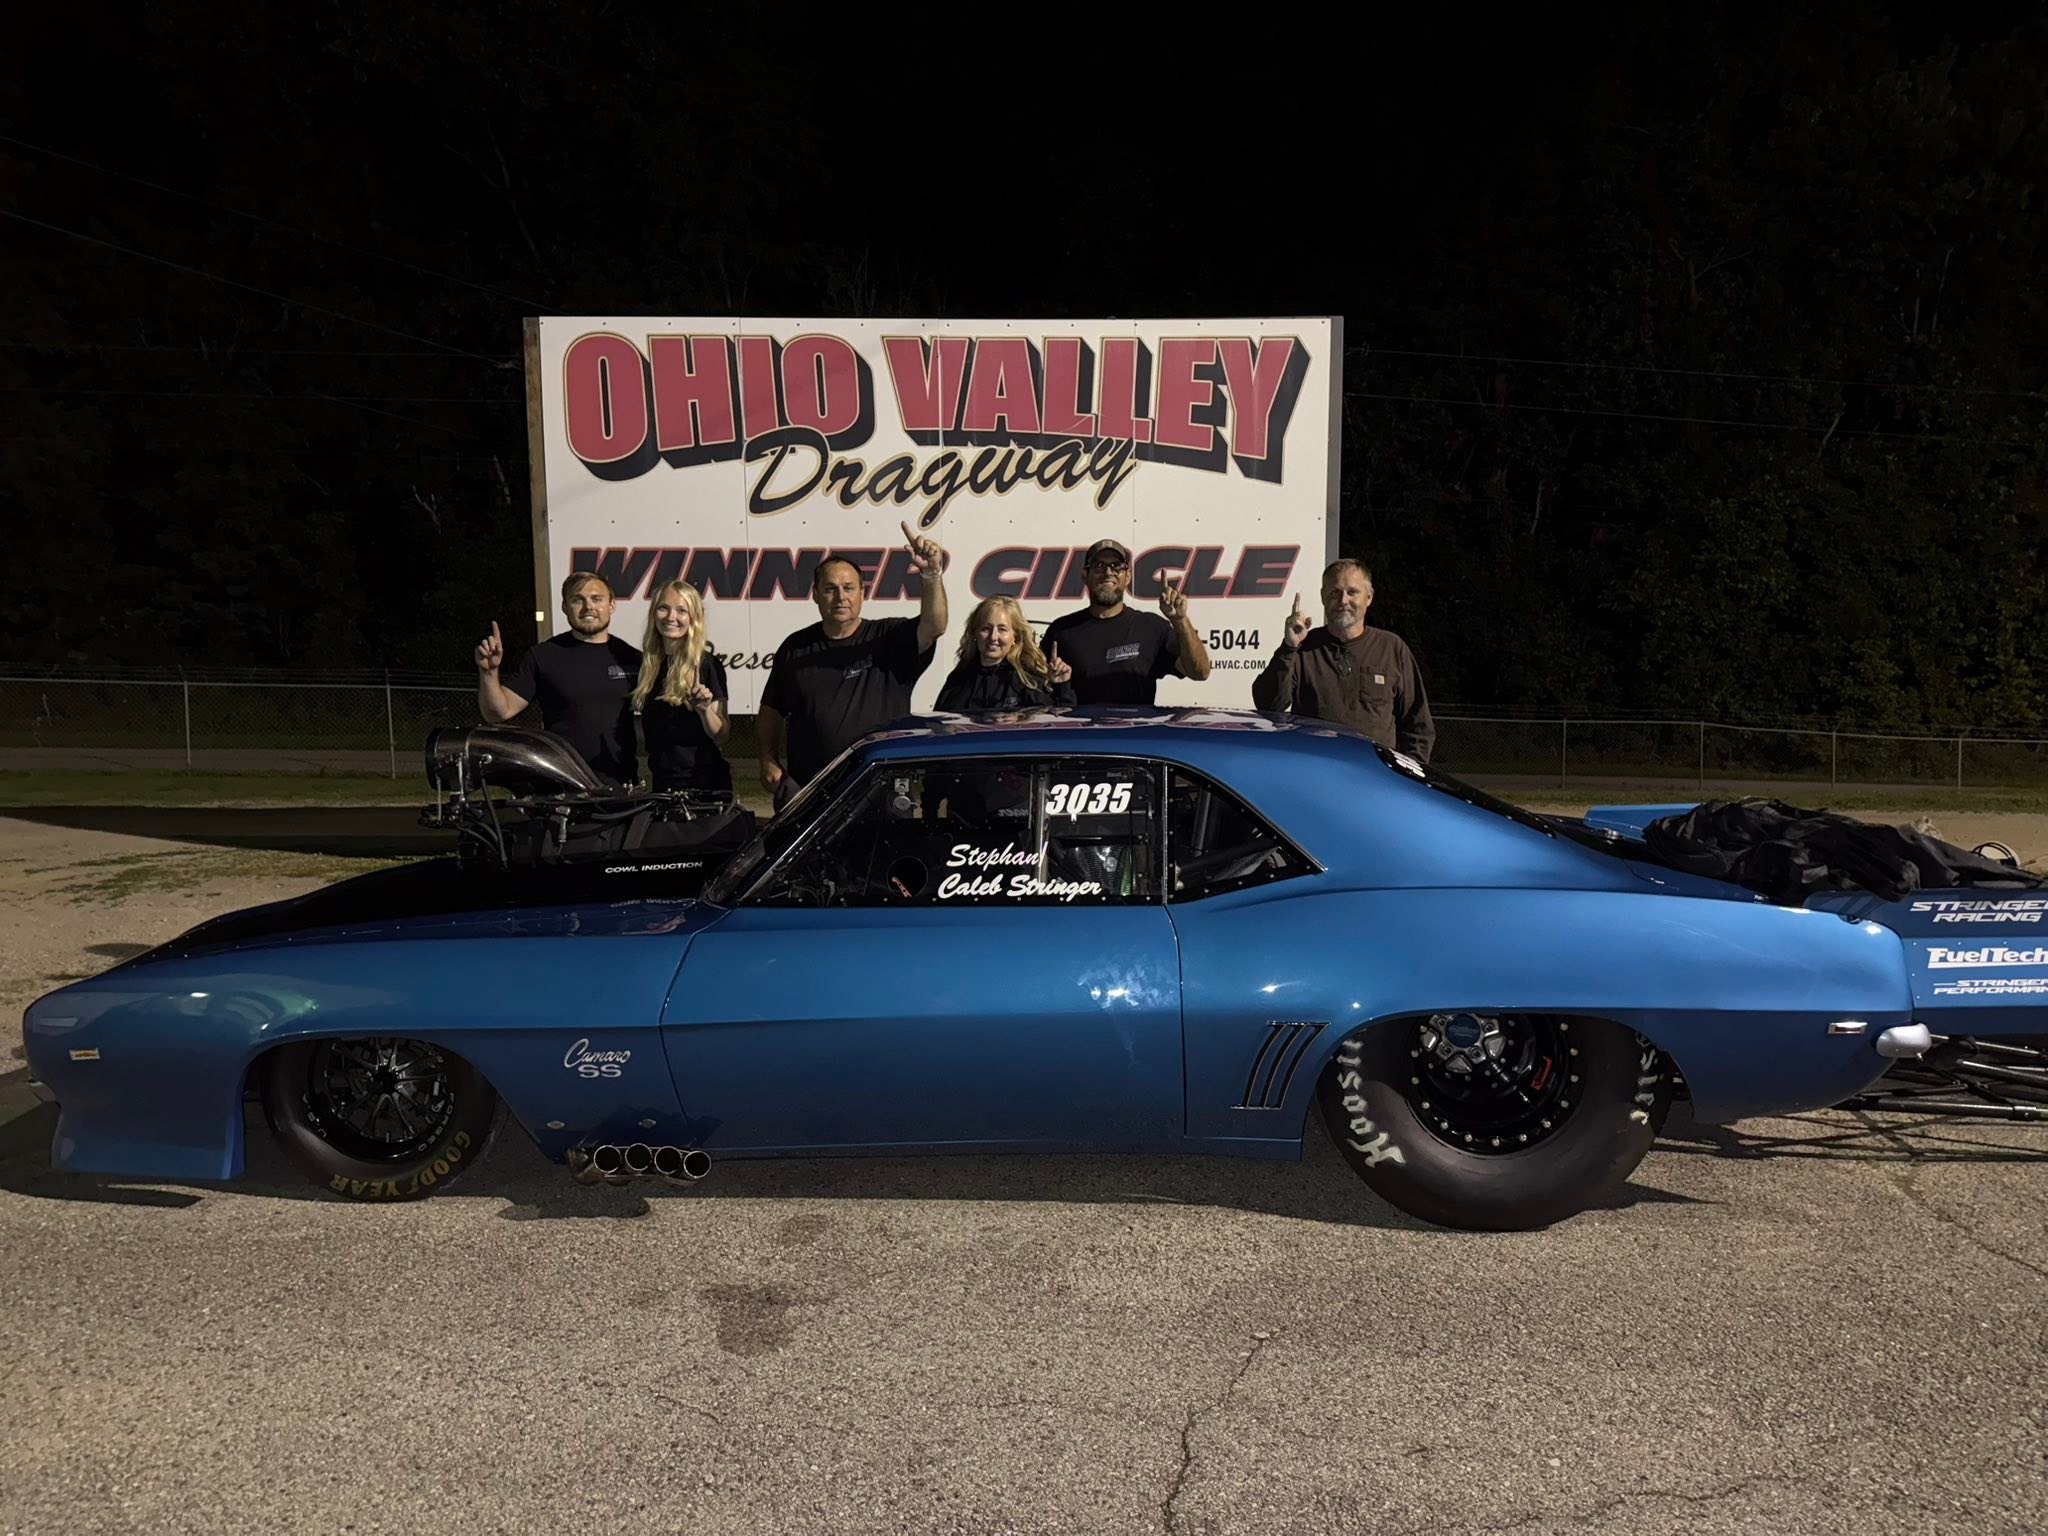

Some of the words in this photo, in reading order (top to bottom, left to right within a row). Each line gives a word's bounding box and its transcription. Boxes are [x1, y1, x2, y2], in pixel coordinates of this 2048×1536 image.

[563, 332, 876, 481] OHIO
[881, 335, 1311, 485] VALLEY
[744, 425, 1139, 529] Dragway
[1045, 783, 1134, 815] 3035
[604, 866, 639, 874] COWL
[641, 861, 703, 872] INDUCTION
[938, 873, 1003, 899] Caleb
[1007, 874, 1102, 902] Stringer
[1932, 912, 2043, 922] RACING
[563, 1038, 631, 1069] Camaro
[577, 1063, 622, 1079] SS
